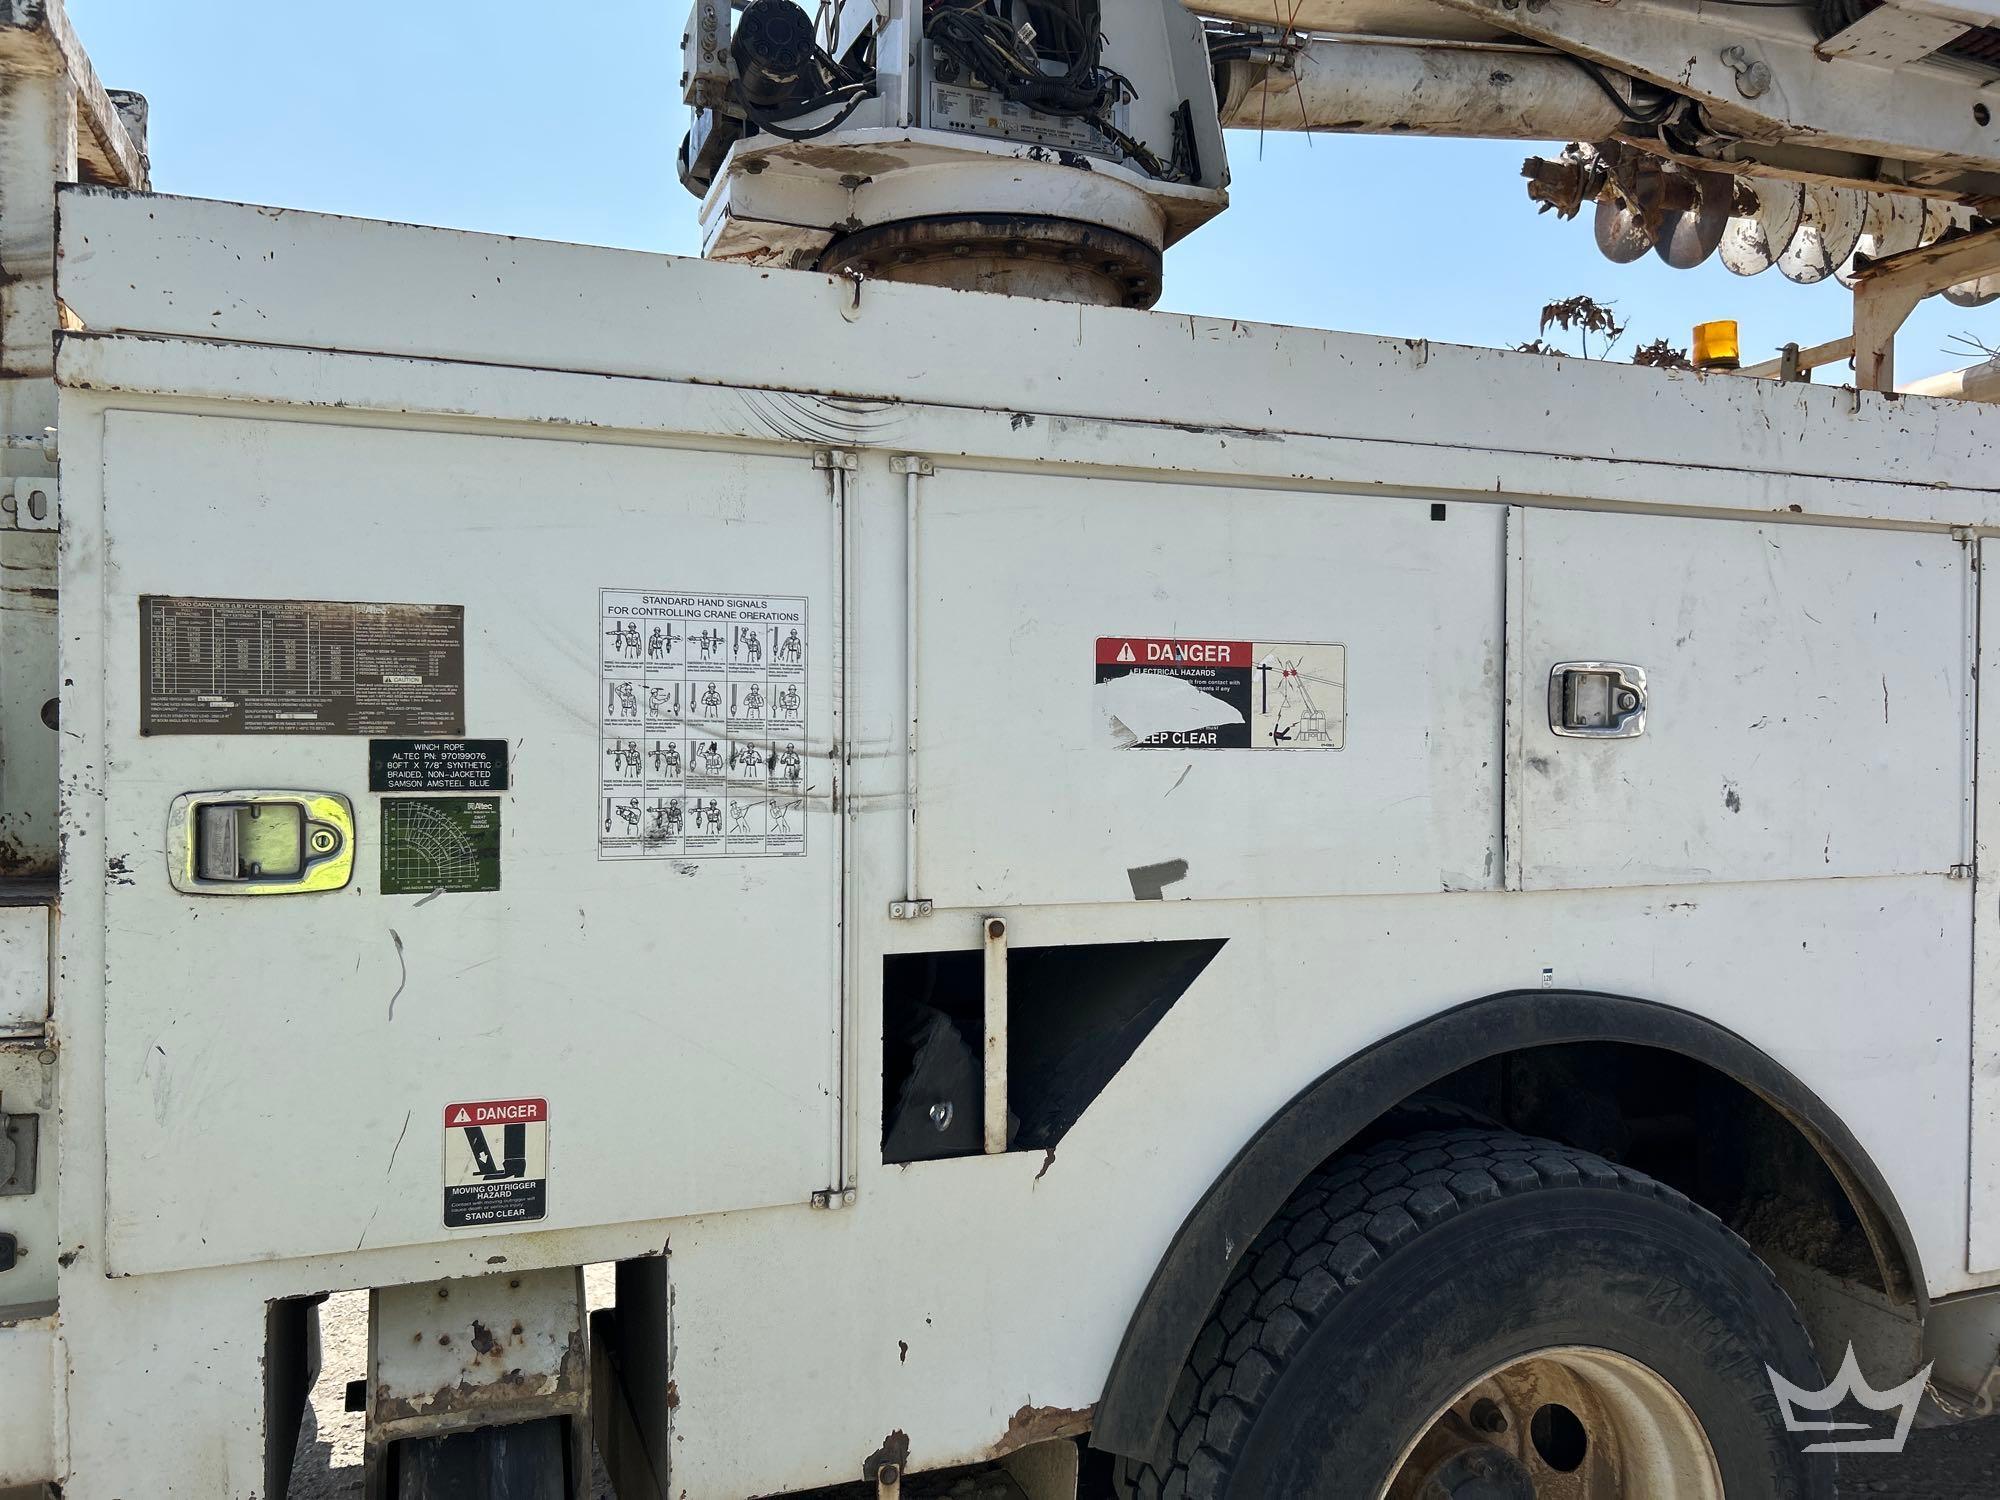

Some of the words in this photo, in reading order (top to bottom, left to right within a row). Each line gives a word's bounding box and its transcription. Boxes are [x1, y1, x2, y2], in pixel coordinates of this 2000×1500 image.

[642, 596, 695, 606] STANDARD
[697, 598, 724, 607] HAND
[727, 600, 768, 609] SIGNALS
[608, 606, 629, 615] FOR
[631, 607, 701, 618] CONTROLLING
[704, 609, 737, 619] CRANE
[739, 611, 799, 622] OPERATIONS
[1147, 643, 1231, 662] DANGER
[1134, 667, 1179, 676] ELECTRICAL
[1180, 668, 1216, 677] HAZARDS
[1143, 733, 1169, 744] EEP
[1172, 733, 1217, 744] CLEAR
[414, 743, 440, 751] WINCH
[444, 743, 466, 751] ROPE
[392, 752, 420, 760] ALTEC
[441, 752, 487, 760] 970199076
[414, 761, 420, 769] X
[424, 761, 443, 769] 7/8"
[447, 761, 492, 769] SYNTHETIC
[387, 771, 424, 779] BRAIDED,
[428, 770, 491, 779] NON-JACKETED
[388, 780, 423, 788] SAMSON
[427, 780, 465, 788] AMSTEEL
[469, 780, 491, 788] BLUE
[476, 1104, 537, 1120] DANGER
[452, 1185, 485, 1195] MOVING
[487, 1181, 537, 1192] OUTRIGGER
[477, 1190, 512, 1200] HAZARD
[465, 1211, 494, 1221] STAND
[496, 1208, 526, 1218] CLEAR
